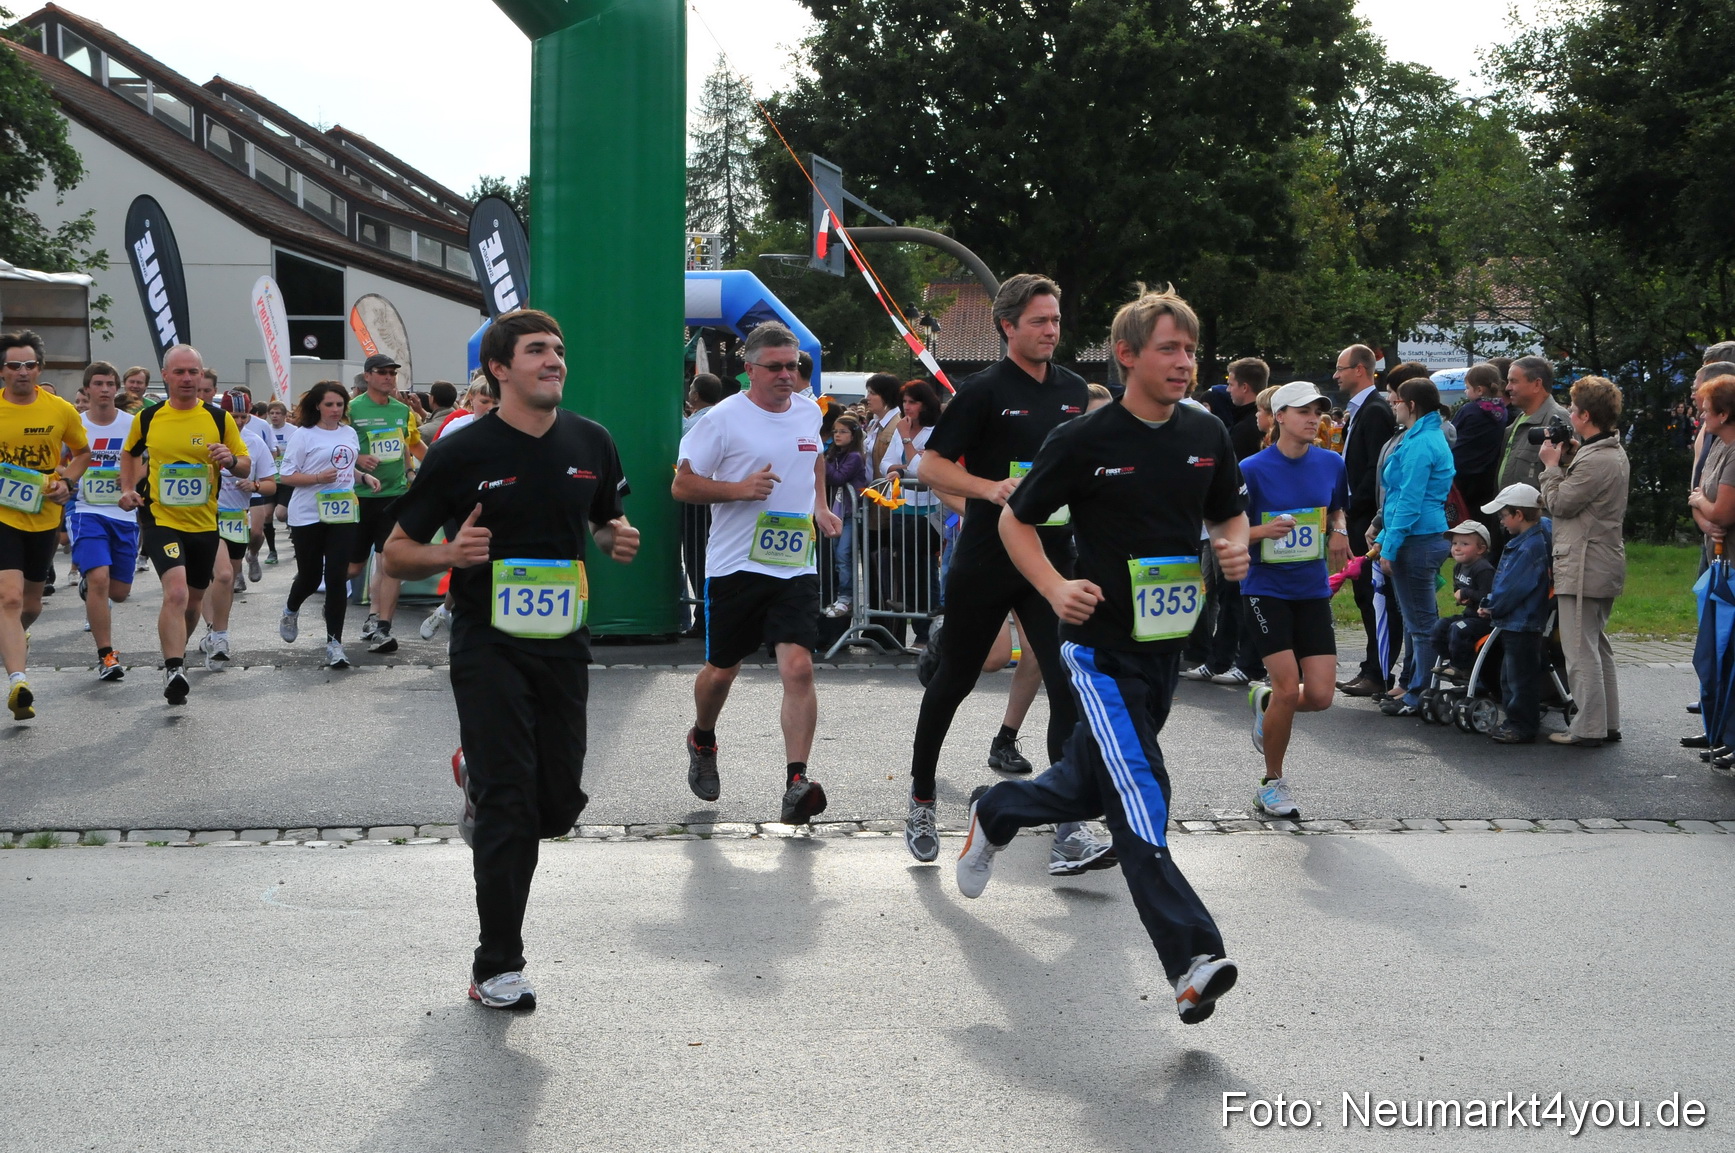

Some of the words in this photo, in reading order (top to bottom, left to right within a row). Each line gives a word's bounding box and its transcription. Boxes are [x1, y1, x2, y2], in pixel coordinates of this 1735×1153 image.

[371, 440, 400, 453] 1192
[164, 479, 203, 496] 769
[322, 501, 350, 515] 792
[167, 547, 178, 555] FC
[760, 529, 803, 553] 636
[498, 587, 570, 616] 1351
[1137, 585, 1197, 617] 1353
[1253, 605, 1269, 634] odlo
